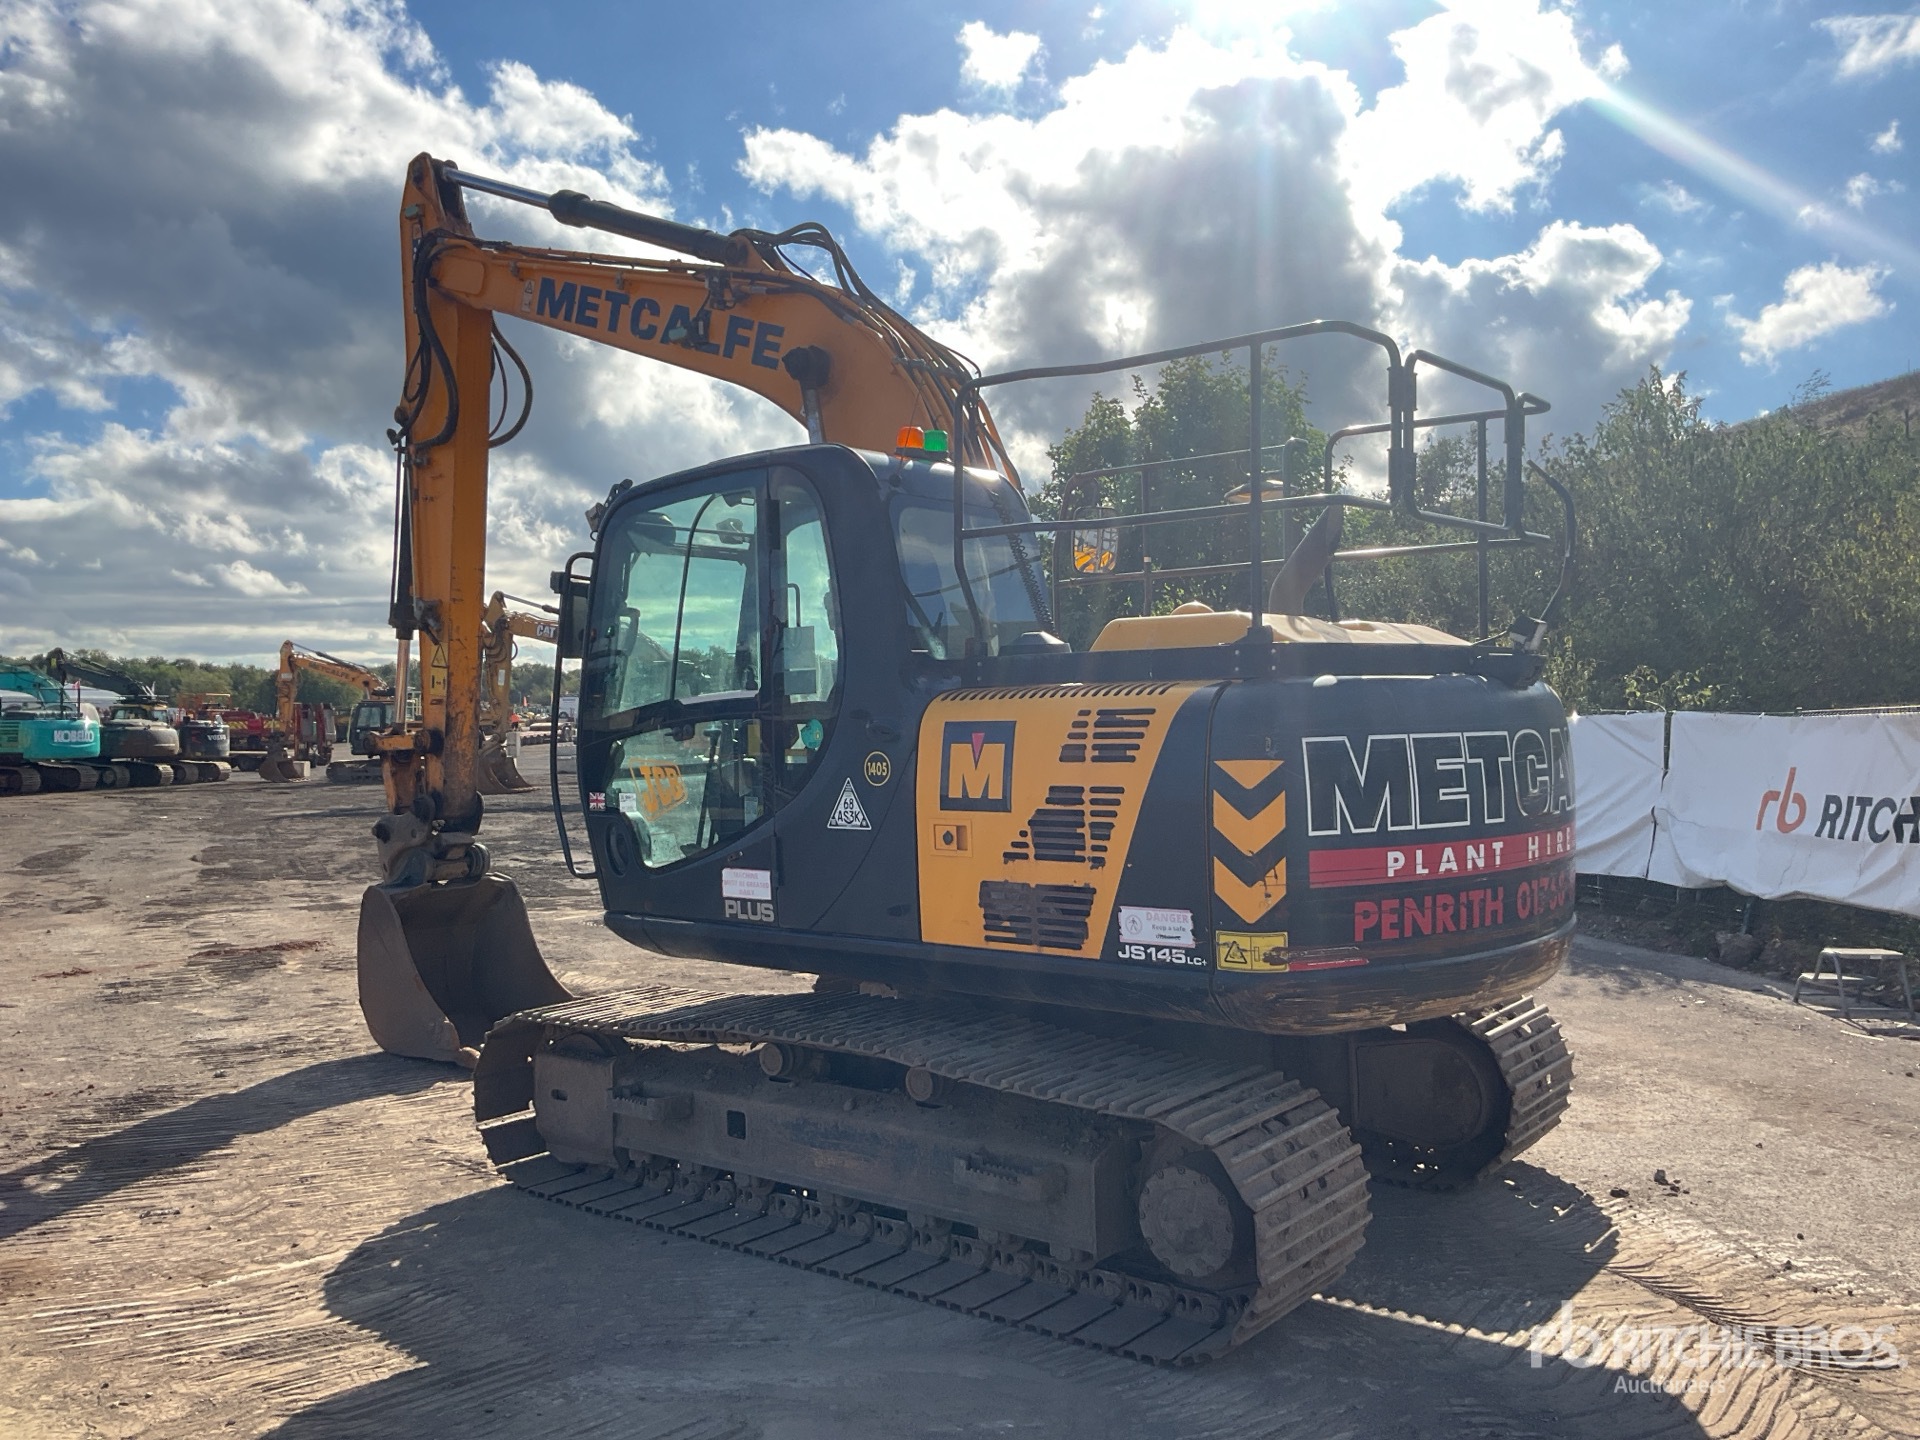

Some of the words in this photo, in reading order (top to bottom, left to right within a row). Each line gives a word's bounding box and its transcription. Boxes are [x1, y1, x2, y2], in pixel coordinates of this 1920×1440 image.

[536, 277, 785, 370] METCALFE
[536, 624, 556, 638] CAT
[53, 729, 95, 743] KOBELCO
[867, 761, 888, 776] 1405
[639, 765, 685, 813] JCB
[843, 797, 854, 810] 68
[1387, 841, 1504, 877] PLANT
[1528, 826, 1572, 862] HIRE
[725, 900, 774, 922] PLUS
[1146, 911, 1189, 923] DANGER
[1354, 887, 1504, 942] PENRITH
[1151, 924, 1167, 932] Keep
